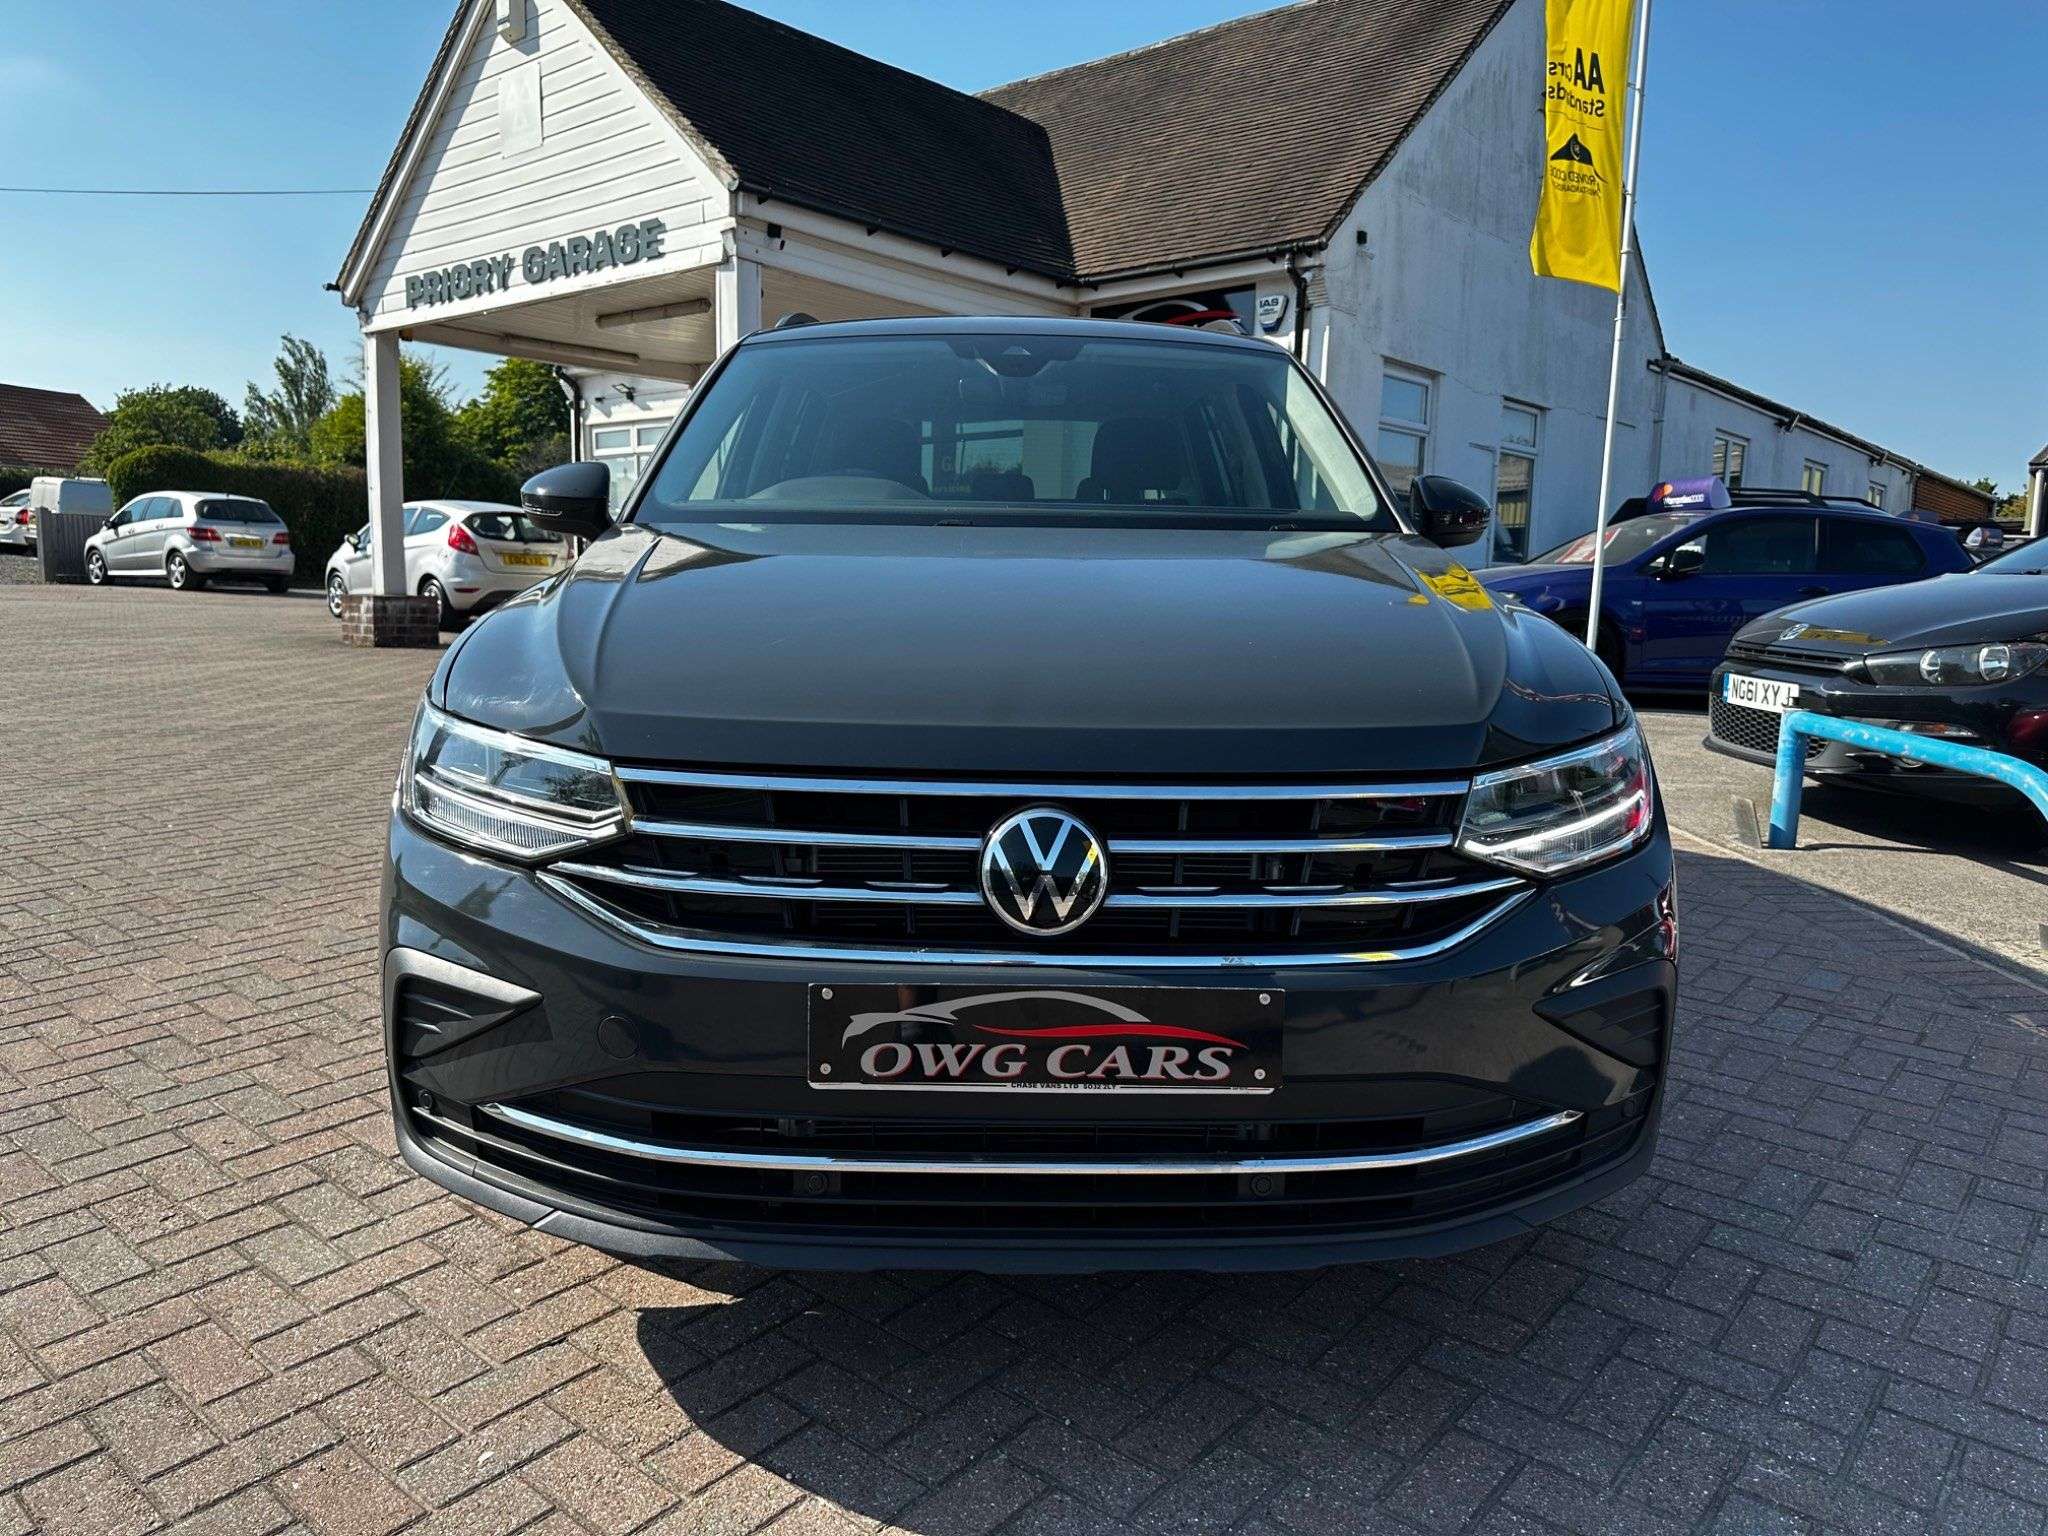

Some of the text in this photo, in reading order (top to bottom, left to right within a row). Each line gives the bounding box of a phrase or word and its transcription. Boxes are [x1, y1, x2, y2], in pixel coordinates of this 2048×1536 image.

[405, 218, 666, 310] PRIORY GARAGE
[1259, 297, 1279, 309] IAS
[1732, 677, 1757, 702] NG61
[860, 1043, 1233, 1081] OWG CARS
[1011, 1081, 1038, 1089] CHASE
